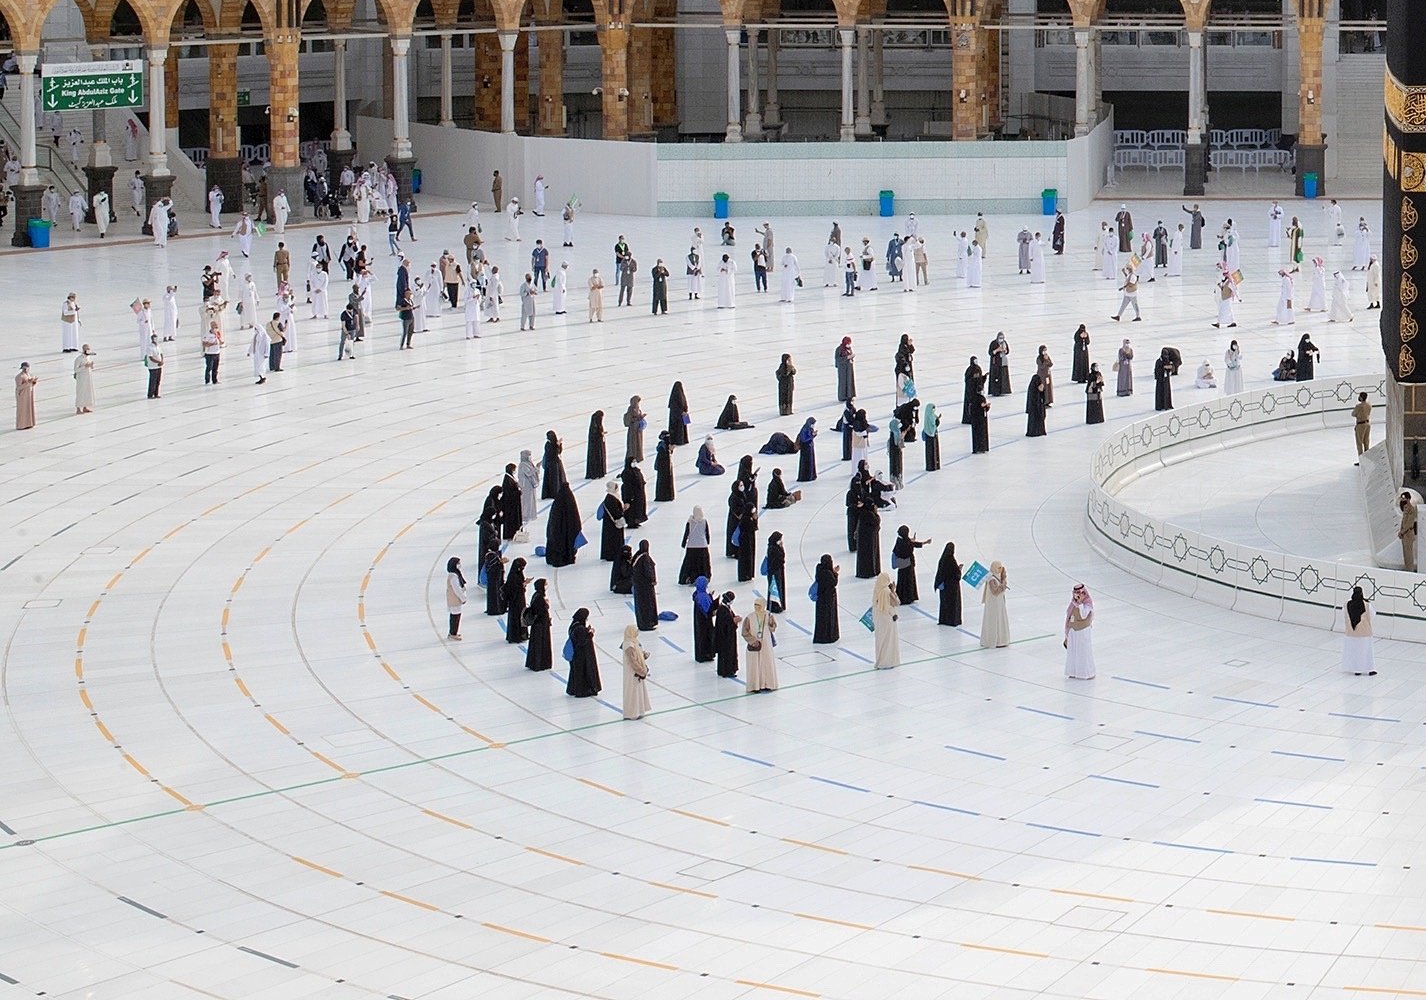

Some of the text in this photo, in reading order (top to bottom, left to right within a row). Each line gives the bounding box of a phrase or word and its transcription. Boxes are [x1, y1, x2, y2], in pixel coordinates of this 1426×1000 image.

[96, 77, 110, 85] الملك
[111, 77, 124, 86] باب
[77, 88, 108, 96] AbdulAziz
